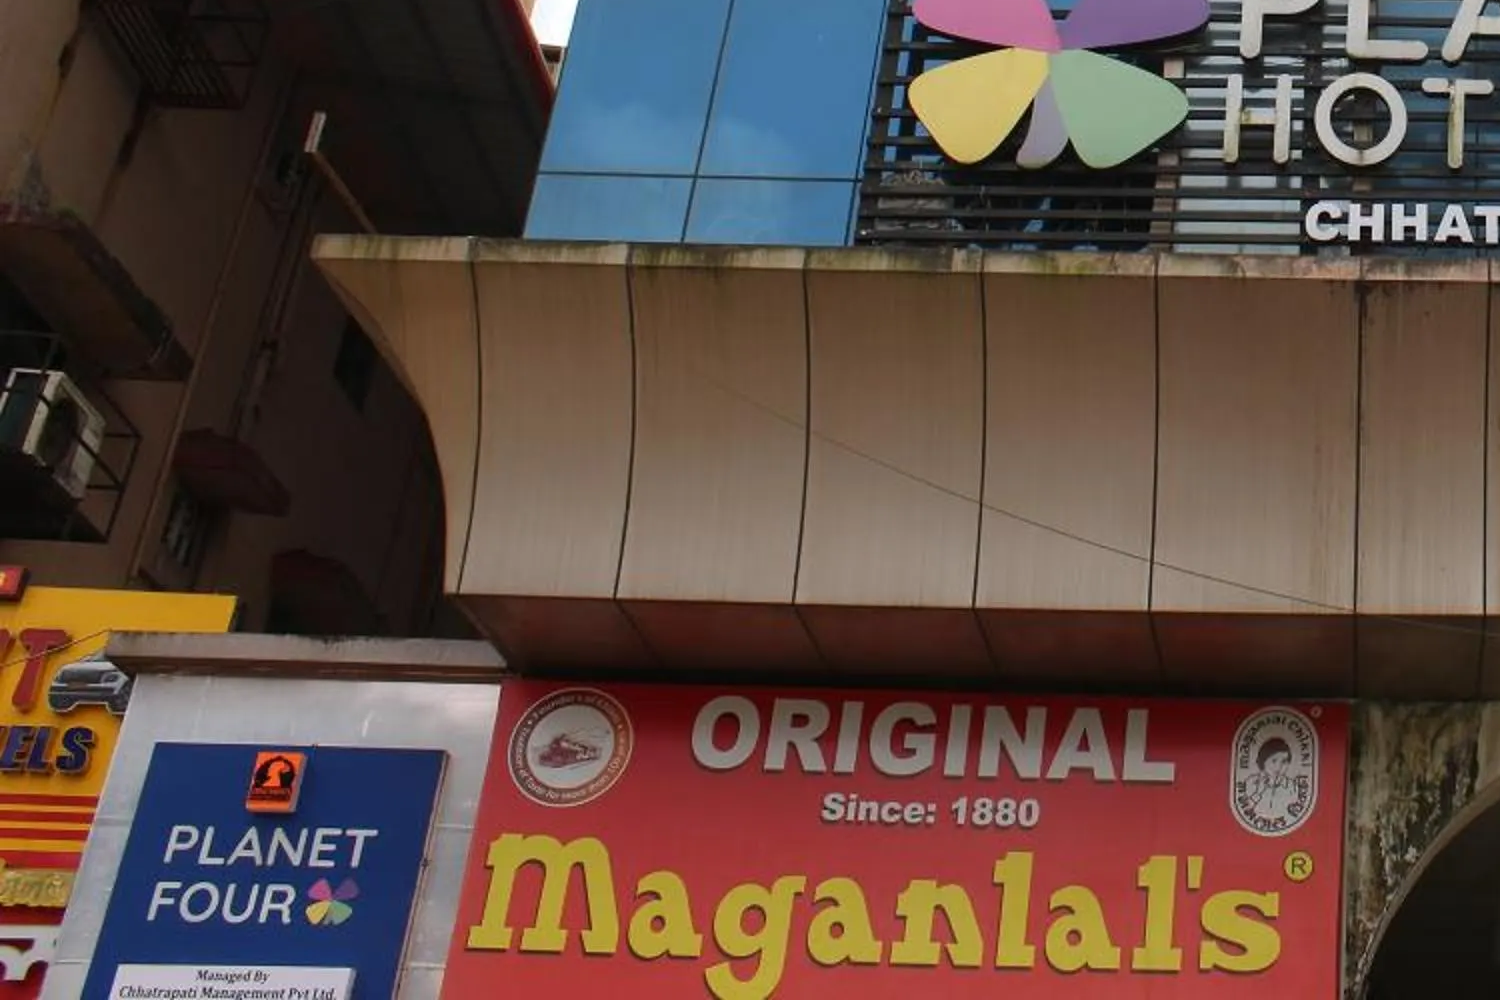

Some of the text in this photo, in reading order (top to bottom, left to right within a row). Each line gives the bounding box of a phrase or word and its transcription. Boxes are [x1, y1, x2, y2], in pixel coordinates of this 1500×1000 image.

[0, 628, 73, 713] T
[0, 725, 97, 775] ELS
[690, 695, 1176, 781] ORIGINAL
[821, 793, 1041, 827] Since: 1880
[163, 825, 379, 869] PLANET
[147, 881, 297, 924] FOUR
[118, 984, 197, 1000] Chhatrapati
[200, 986, 284, 1000] Management
[287, 988, 310, 1000] Pvt
[196, 968, 271, 984] Managed By
